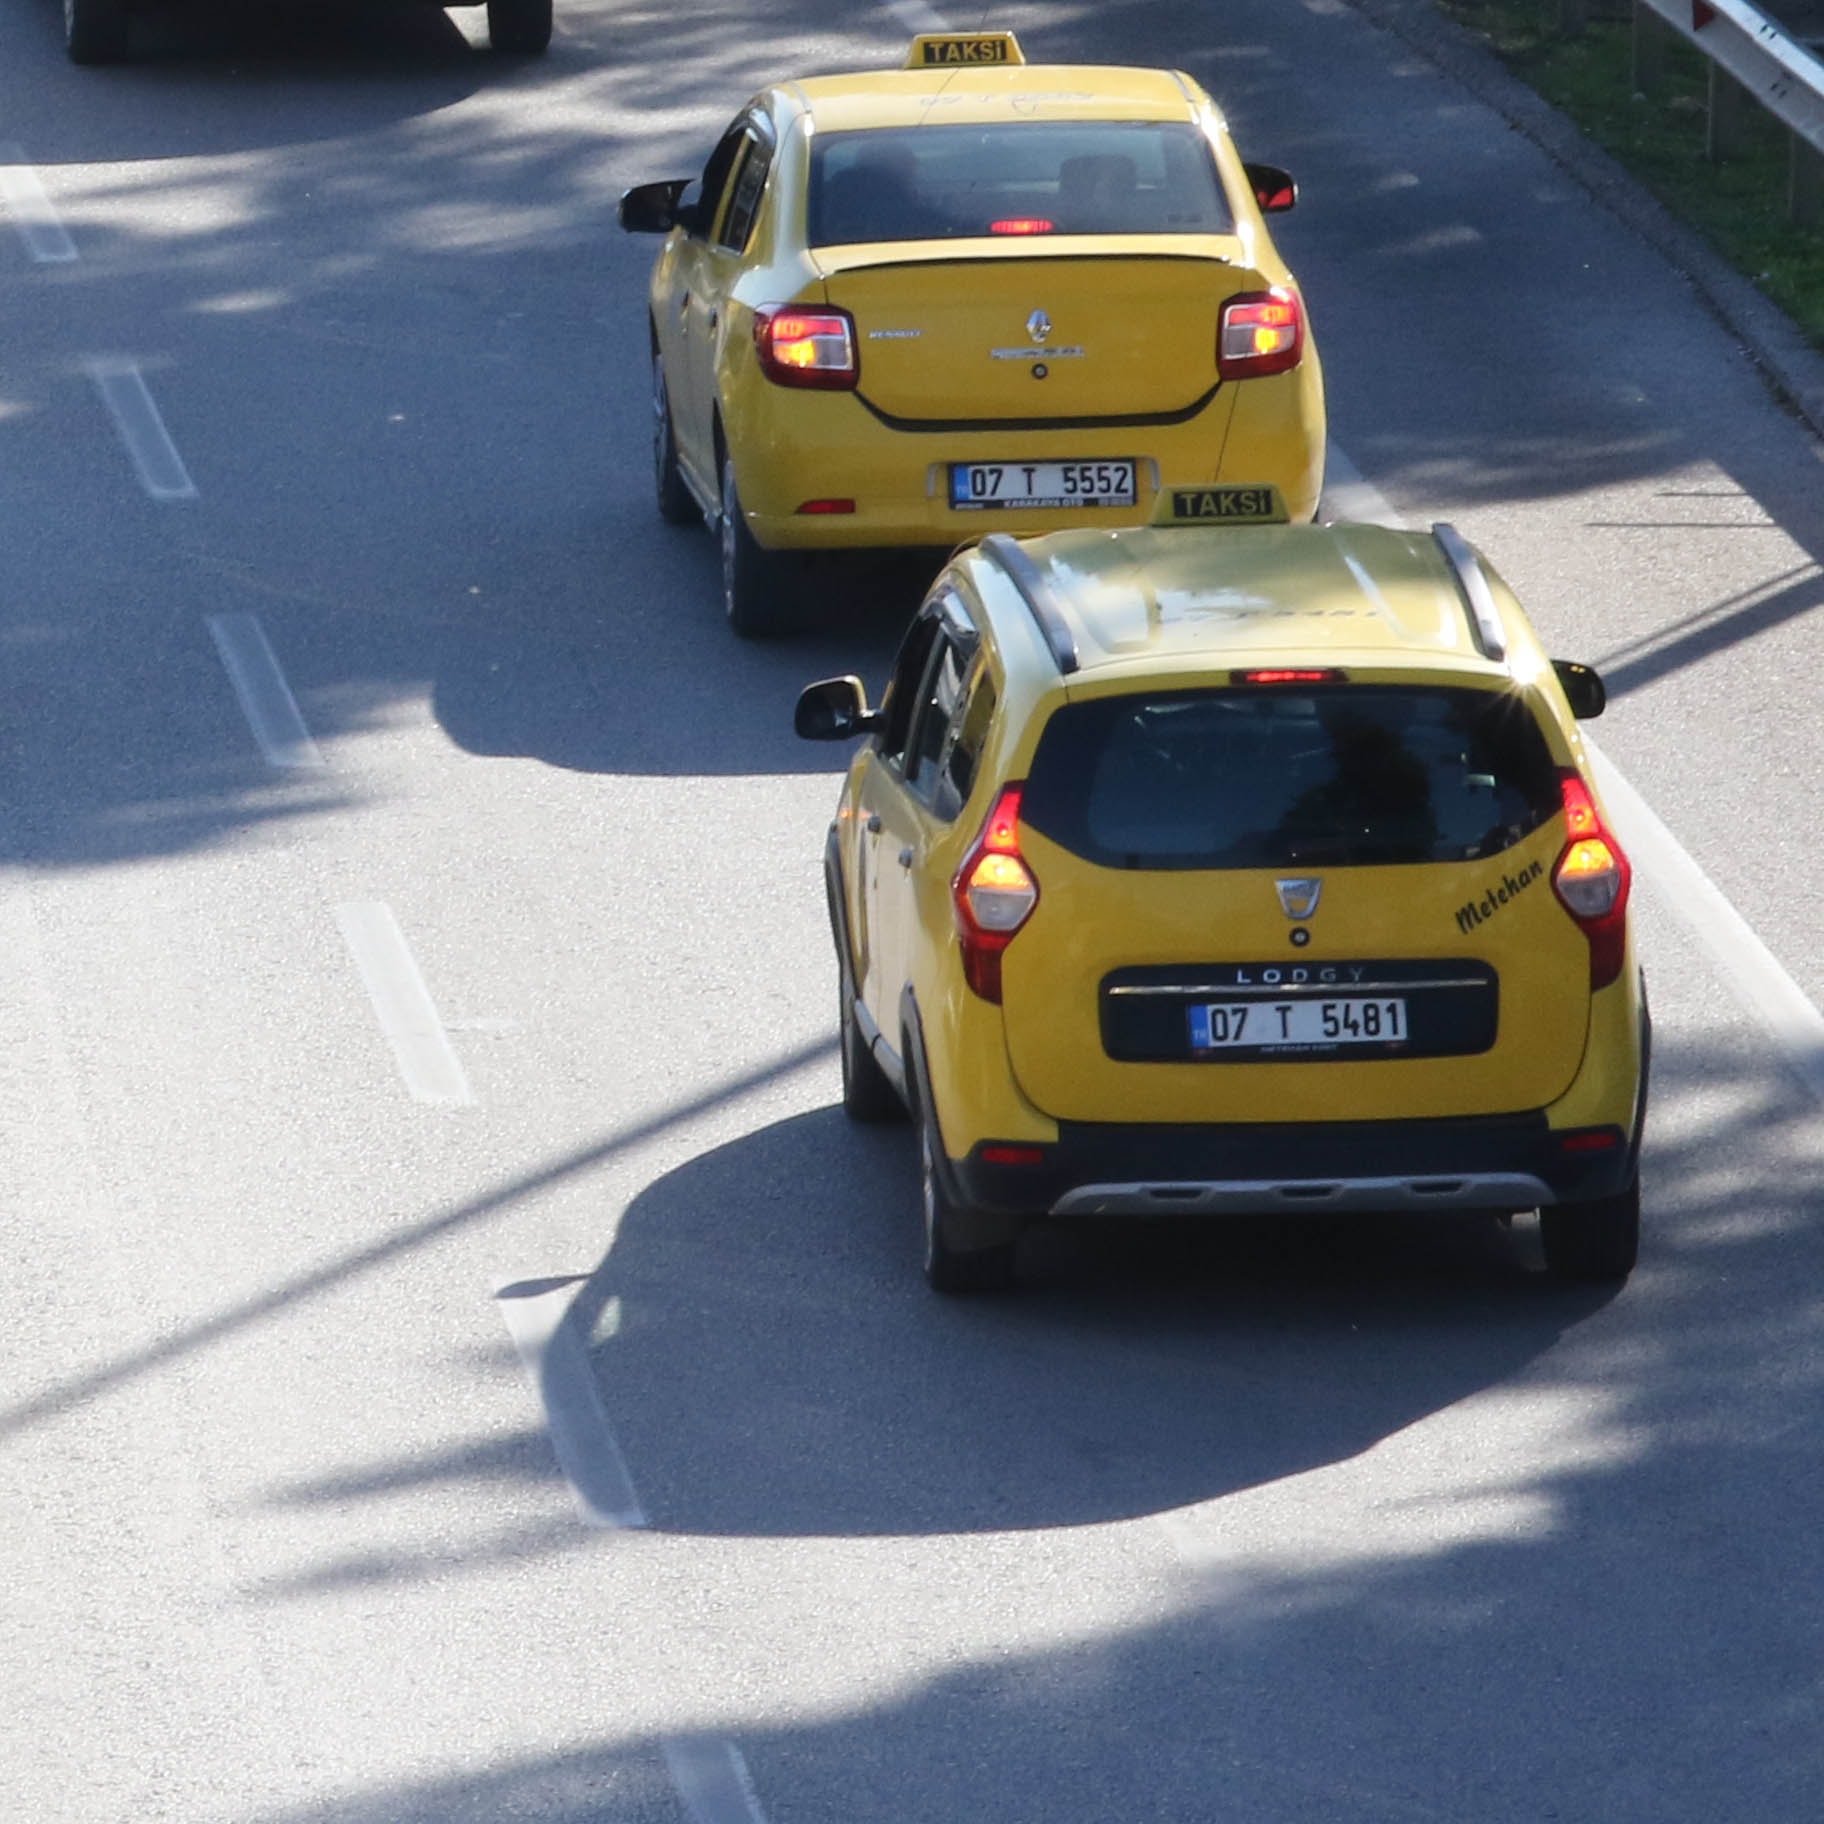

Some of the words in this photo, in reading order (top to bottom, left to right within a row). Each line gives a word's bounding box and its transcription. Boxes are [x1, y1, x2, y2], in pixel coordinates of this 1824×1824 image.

[970, 471, 1003, 497] 07
[1021, 470, 1038, 495] T
[1062, 467, 1129, 495] 5552
[1455, 861, 1543, 934] Metehan
[1237, 967, 1363, 983] LODGY
[1209, 1008, 1248, 1042] 07
[1274, 1006, 1292, 1039] T
[1321, 1003, 1400, 1037] 5481
